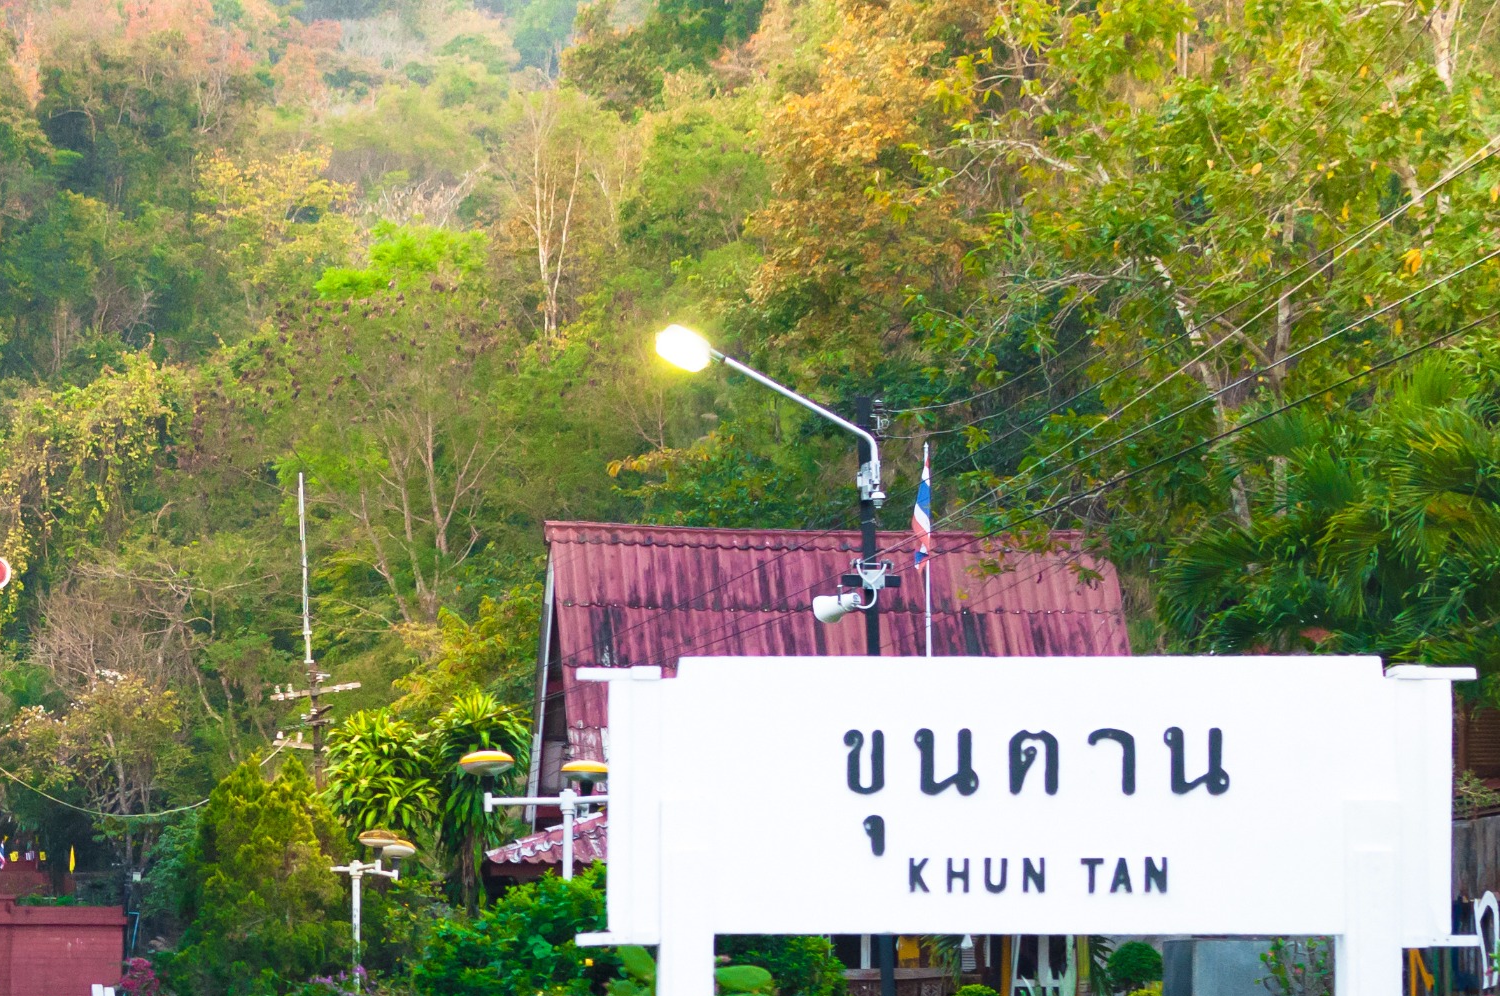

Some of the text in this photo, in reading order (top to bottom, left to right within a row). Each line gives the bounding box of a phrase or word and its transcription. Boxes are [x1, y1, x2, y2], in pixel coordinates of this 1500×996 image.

[842, 726, 1230, 857] ขุนตาน
[908, 857, 1168, 894] KHUN TAN
